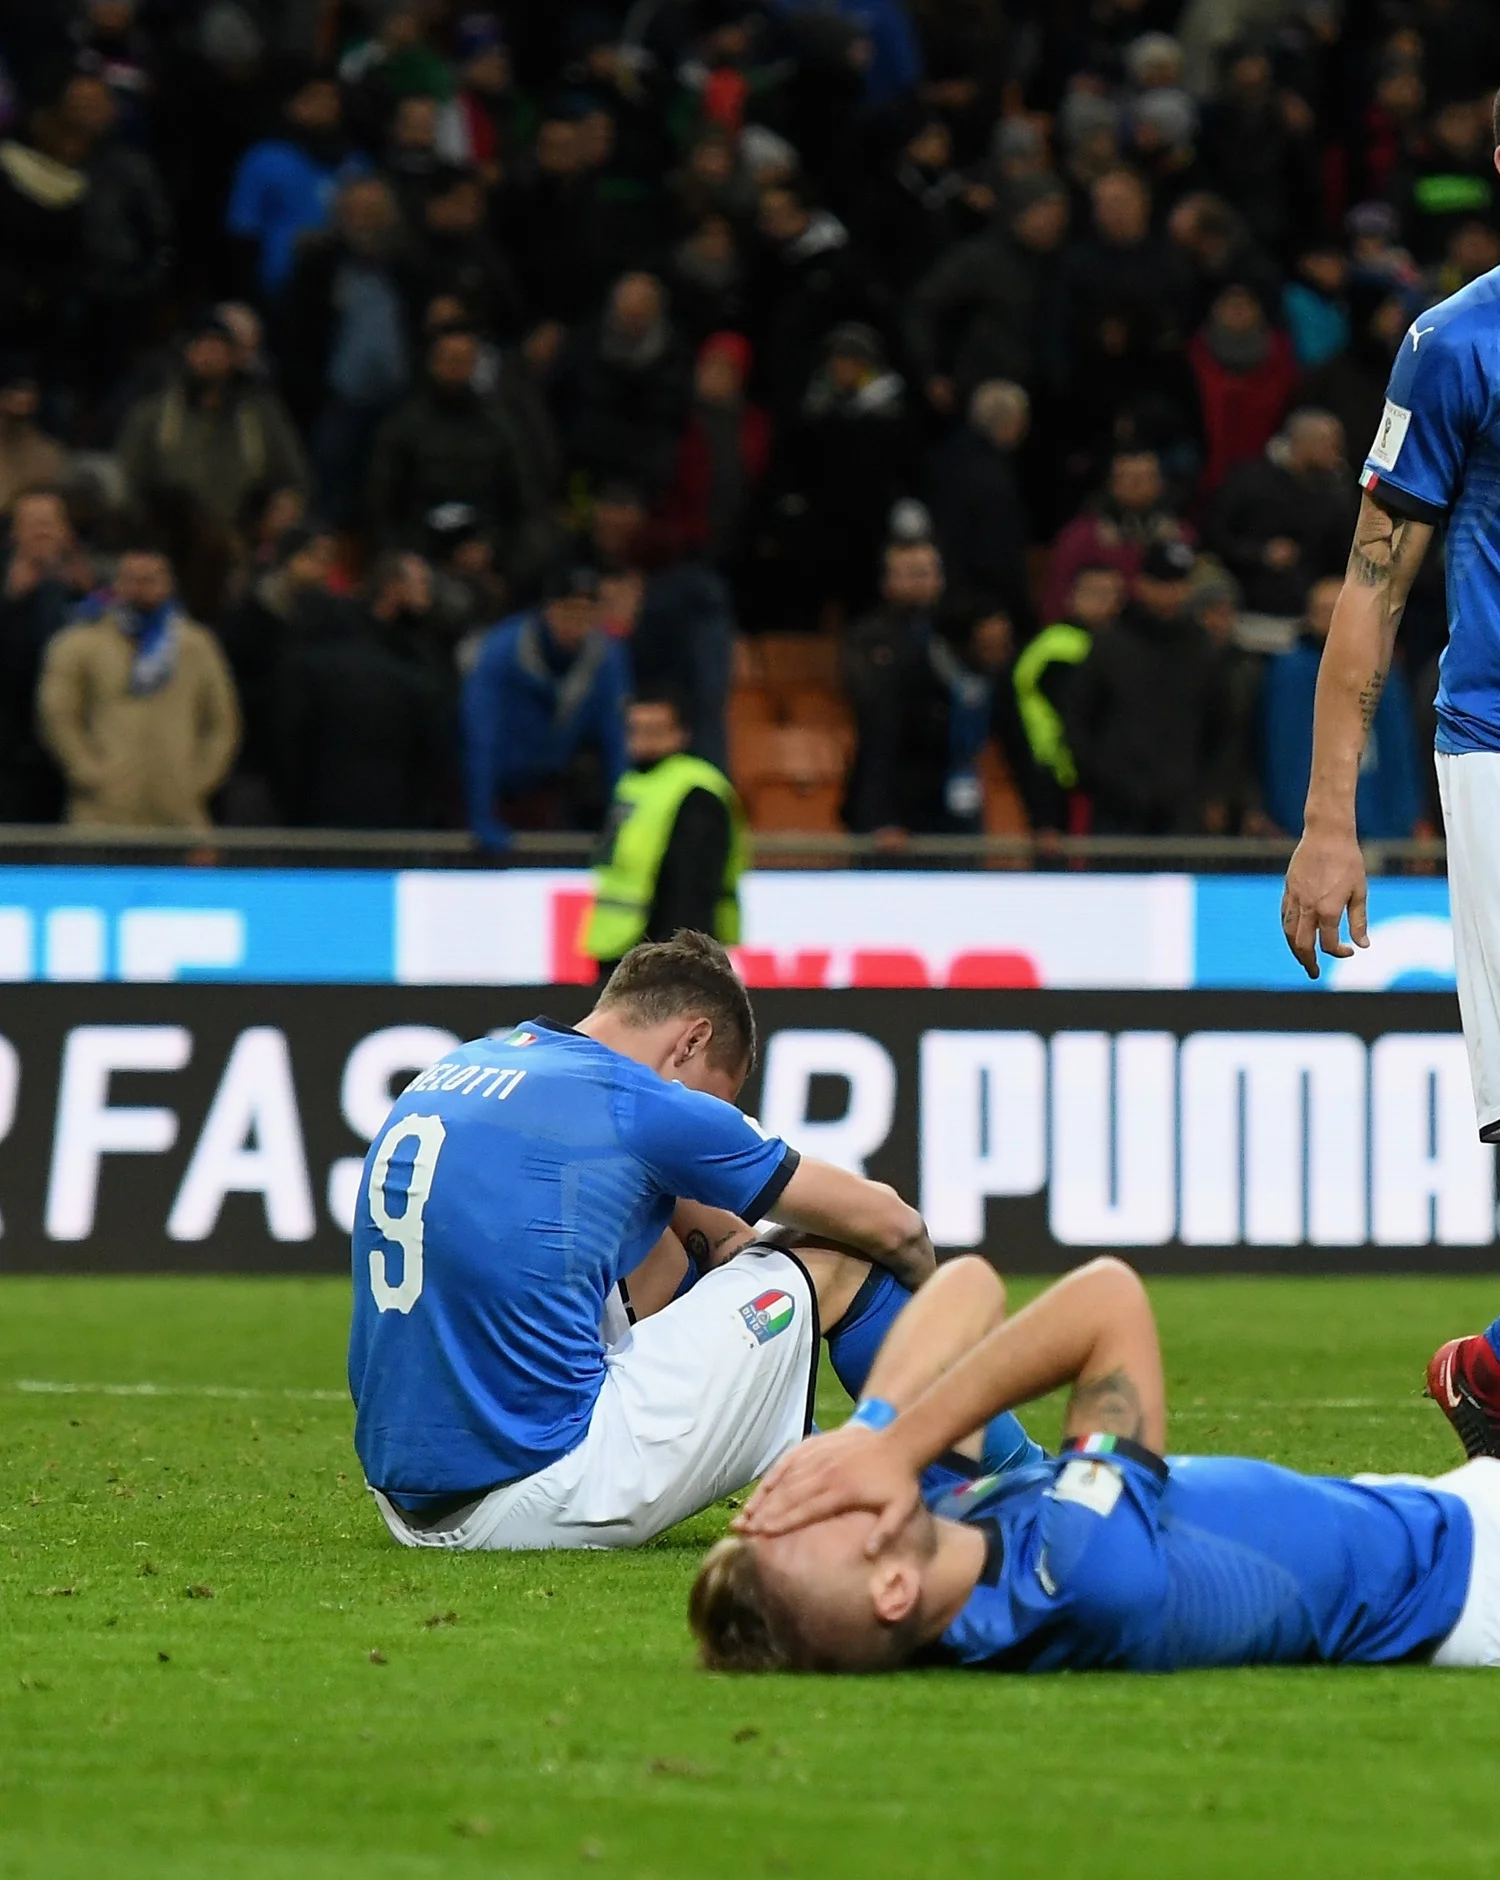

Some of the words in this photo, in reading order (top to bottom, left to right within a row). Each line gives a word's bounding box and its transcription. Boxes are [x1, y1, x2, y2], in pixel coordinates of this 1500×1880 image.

[43, 1024, 897, 1241] FASR
[920, 1028, 1497, 1248] PUMA
[368, 1112, 447, 1315] 9
